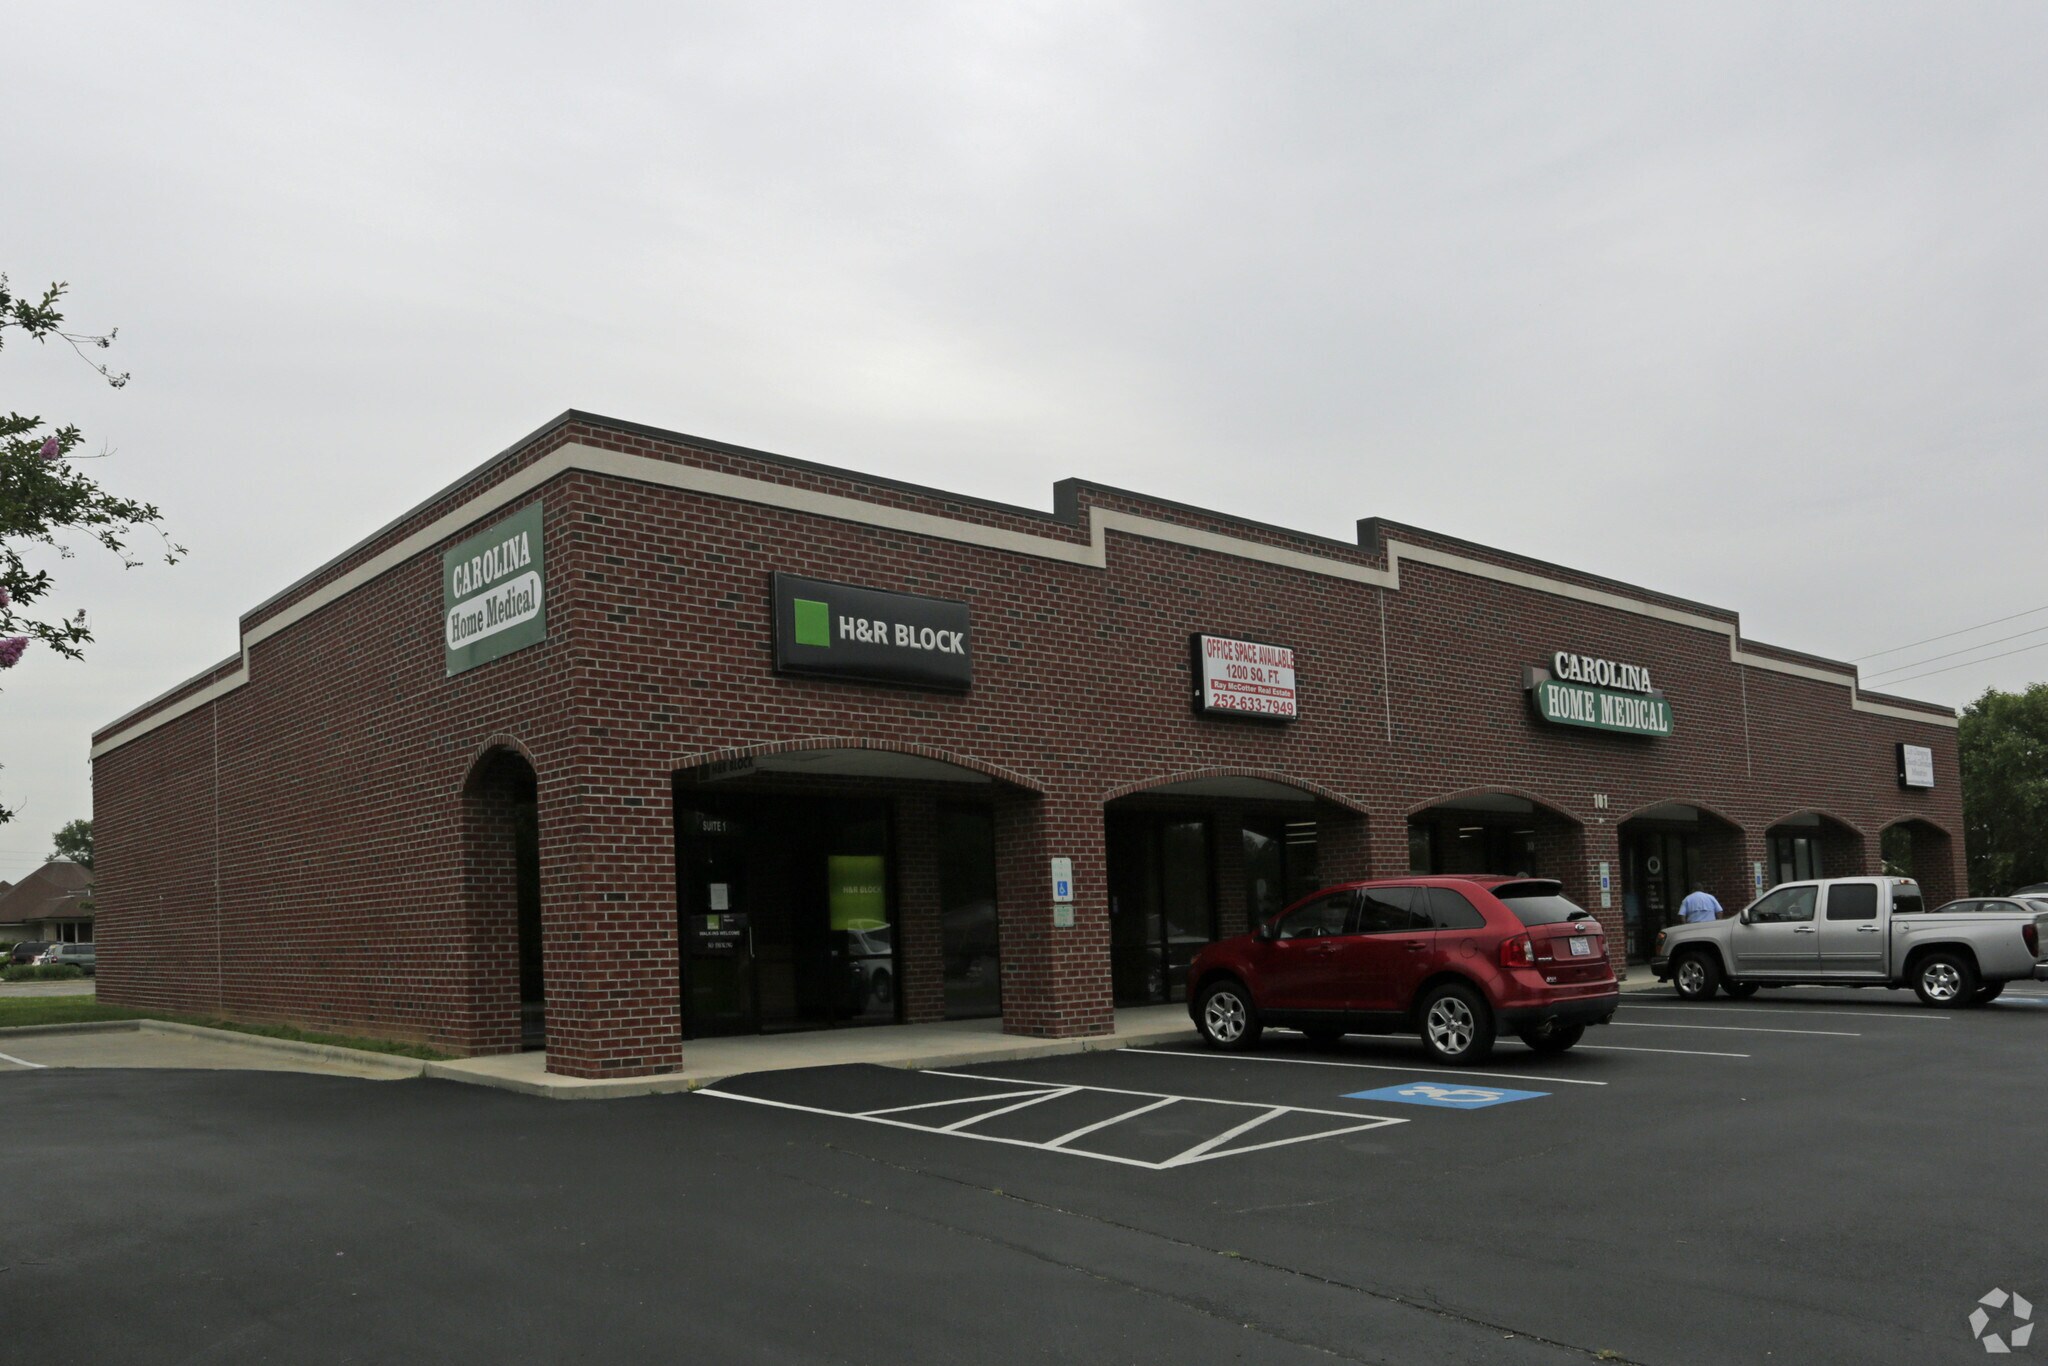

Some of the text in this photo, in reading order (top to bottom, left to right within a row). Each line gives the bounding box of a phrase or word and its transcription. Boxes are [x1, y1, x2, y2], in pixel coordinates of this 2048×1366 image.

[453, 531, 531, 599] CAROLINA
[452, 578, 535, 643] Home Medical
[839, 616, 965, 654] H&R BLOCK
[1207, 639, 1294, 669] OFFICE SPACE AVAILABLE
[1226, 664, 1280, 684] 1200 SQ. FT.
[1554, 651, 1653, 693] CAROLINA
[1214, 681, 1291, 697] Ray McCotter Real Estate
[1213, 694, 1293, 714] 252-633-7949
[1547, 684, 1668, 732] HOME MEDICAL
[1593, 793, 1608, 809] 101
[702, 820, 721, 832] SUITE
[859, 885, 882, 894] BLOCK
